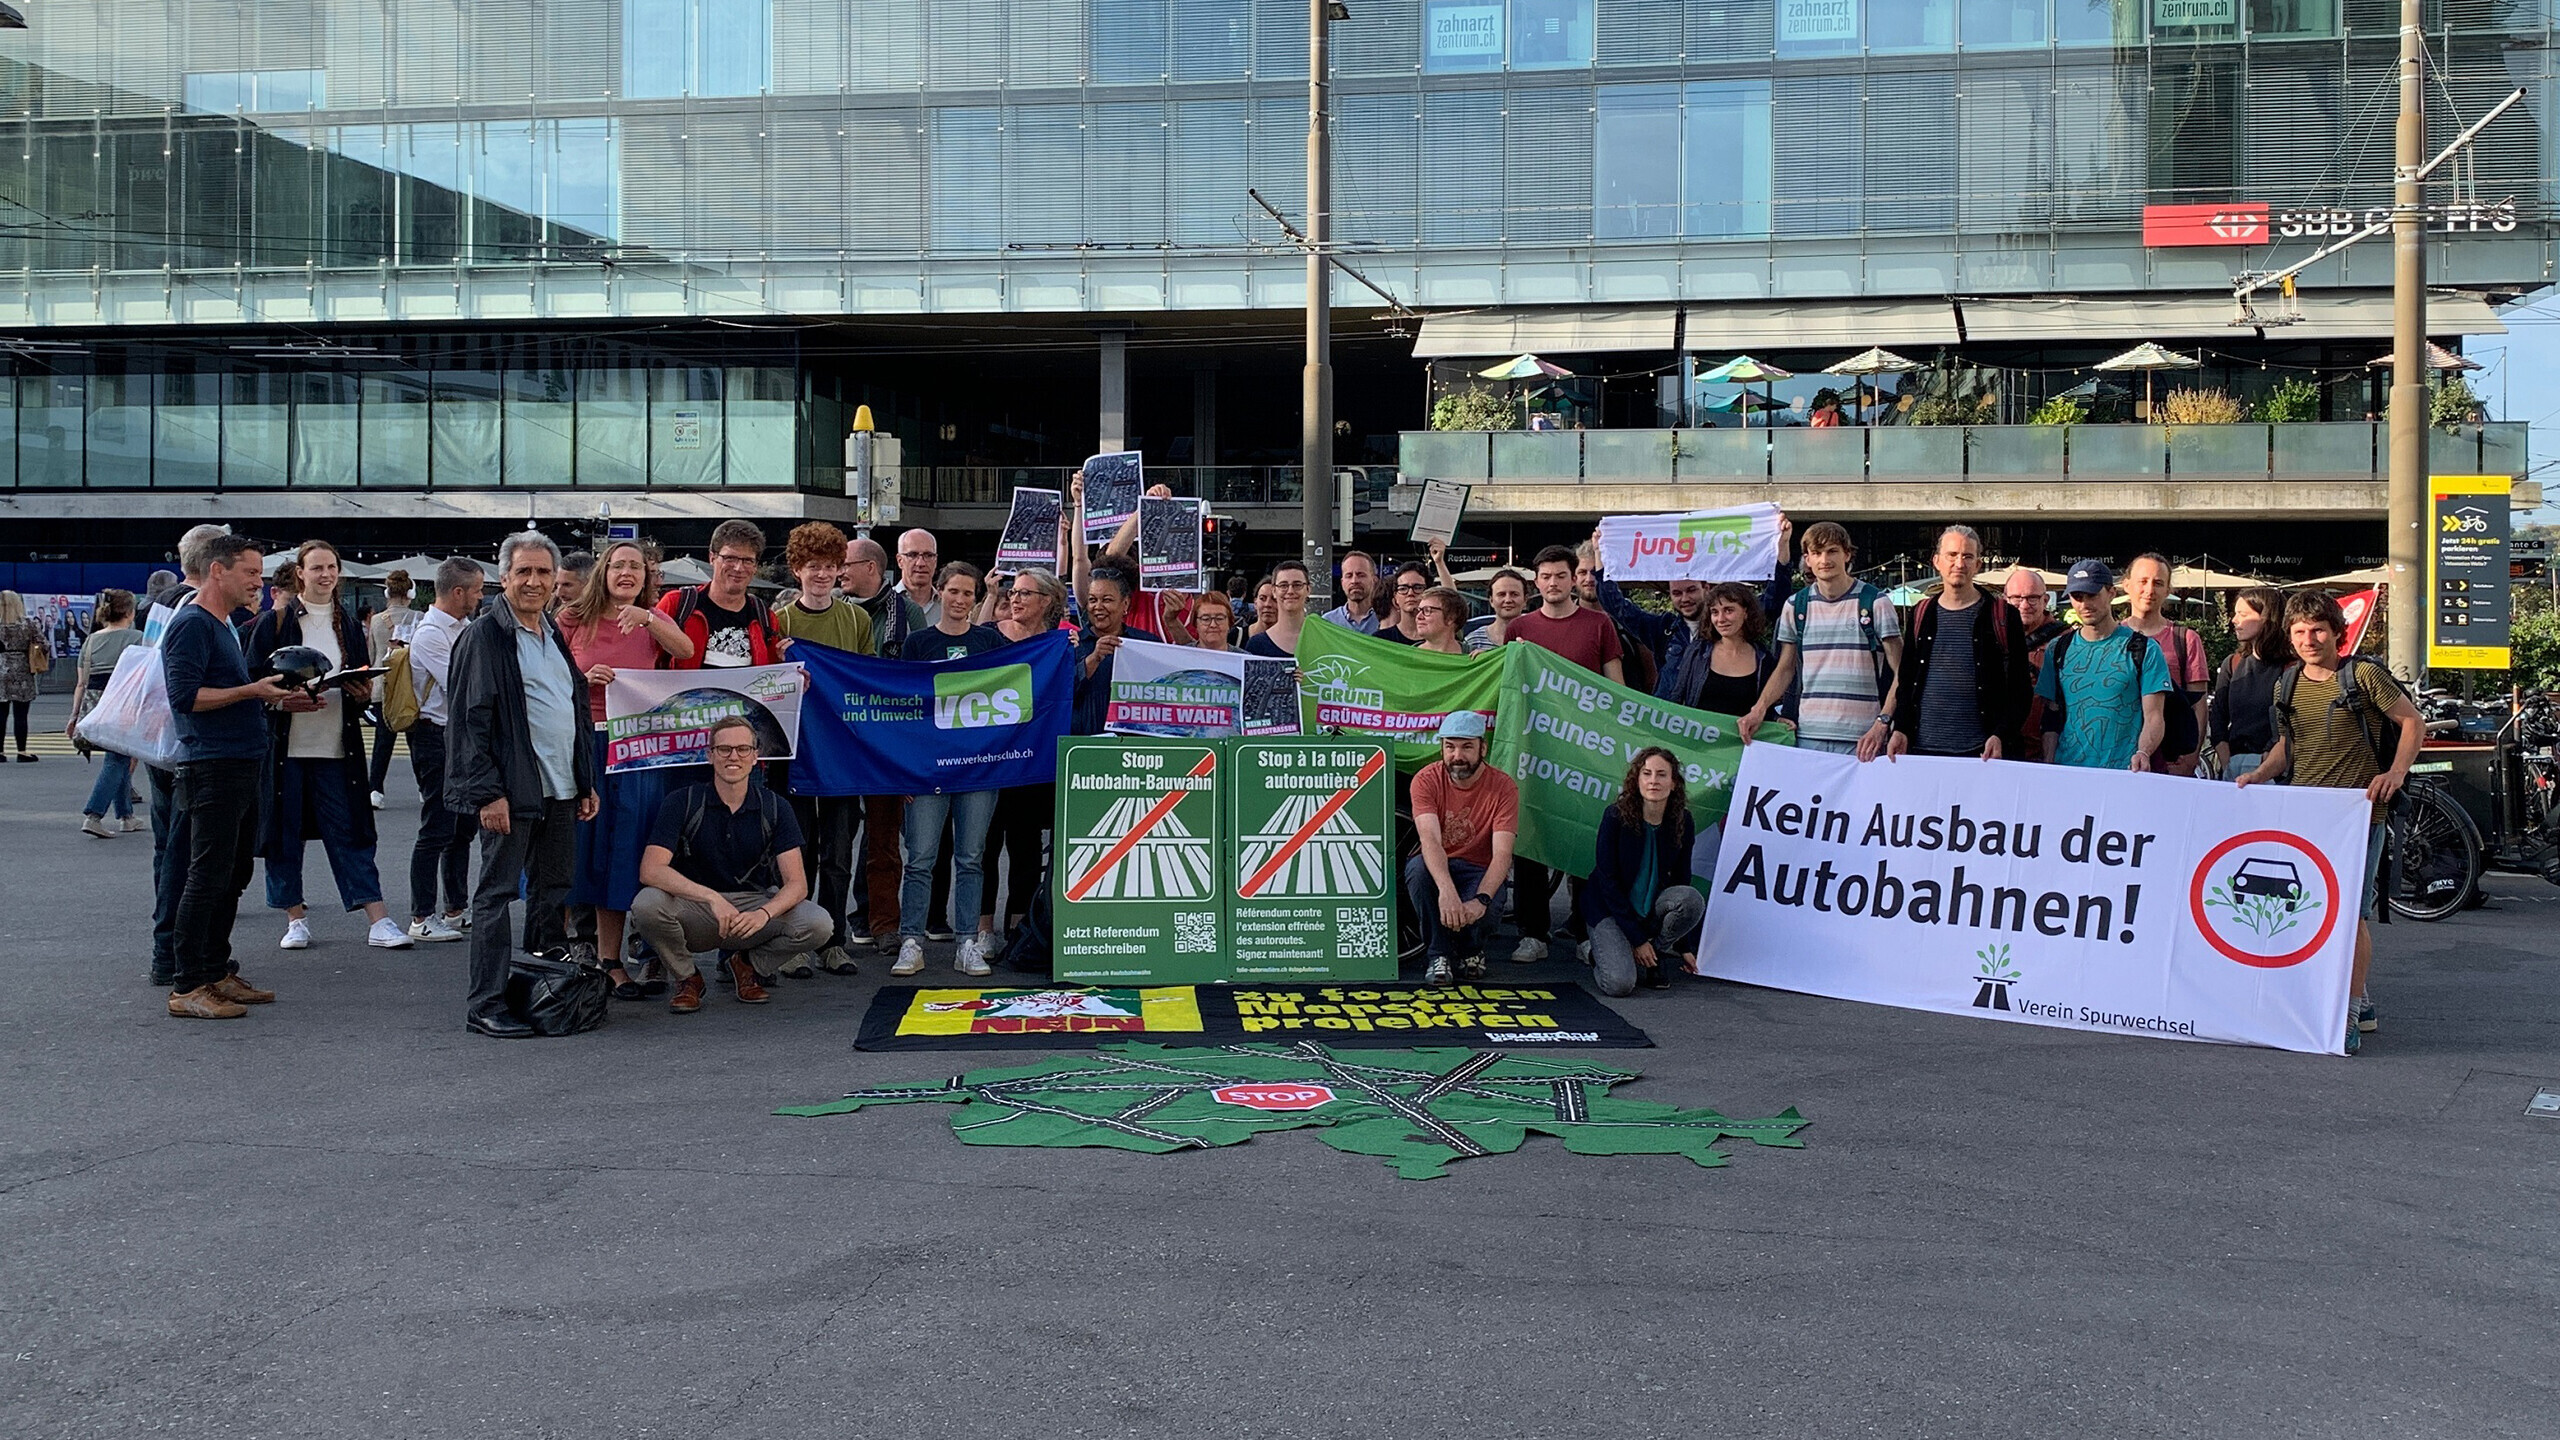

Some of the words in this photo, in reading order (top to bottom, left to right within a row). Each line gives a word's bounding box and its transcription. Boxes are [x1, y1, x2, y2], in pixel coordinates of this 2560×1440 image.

[1788, 0, 1849, 17] zahnarzt
[2162, 1, 2227, 17] zentrum.ch
[1437, 14, 1494, 33] zahnarzt
[1788, 16, 1850, 33] zentrum.ch
[1437, 32, 1495, 48] zentrum.ch
[2280, 208, 2353, 236] SBB
[1448, 554, 1497, 562] Restaurant
[1991, 555, 2020, 564] Away
[2249, 555, 2272, 564] Take
[2274, 555, 2303, 565] Away
[2344, 556, 2387, 564] Restaura
[844, 693, 865, 706] Für
[869, 693, 923, 706] Mensch
[1117, 684, 1178, 702] UNSER
[1182, 687, 1239, 704] KLIMA
[934, 688, 1021, 729] VCS
[1534, 668, 1613, 713] junge
[1616, 699, 1721, 744] gruene
[613, 716, 677, 737] UNSER
[680, 704, 742, 729] KLIMA
[843, 709, 867, 721] und
[870, 709, 924, 721] Umwelt
[1118, 706, 1173, 722] DEINE
[1177, 707, 1229, 725] WAHL
[1319, 707, 1382, 726] GRÜNES
[1522, 709, 1617, 756] jeunes
[616, 735, 670, 761] DEINE
[675, 729, 711, 750] WA
[937, 749, 1034, 767] www.verkehrsclub.ch
[1122, 751, 1164, 770] Stopp
[1258, 751, 1292, 768] Stop
[1297, 750, 1307, 767] à
[1311, 751, 1326, 767] la
[1331, 751, 1366, 767] folie
[1071, 773, 1212, 791] Autobahn-Bauwahn
[1264, 772, 1359, 789] autoroutière
[1518, 751, 1611, 801] giovani
[1742, 785, 1850, 844] Kein
[1860, 803, 2042, 859] Ausbau
[2060, 815, 2156, 868] der
[1723, 844, 2142, 944] Autobahnen!
[1236, 907, 1291, 917] Référendum
[1293, 908, 1322, 917] contre
[1063, 927, 1091, 938] Jetzt
[1093, 926, 1160, 938] Referendum
[1236, 921, 1286, 931] l'extension
[1287, 921, 1326, 931] effrénée
[1236, 935, 1253, 945] des
[1254, 936, 1306, 945] autoroutes.
[1063, 943, 1146, 955] unterschreiben
[1236, 949, 1269, 961] Signez
[1269, 949, 1324, 959] maintenant!
[1237, 1000, 1527, 1017] Monster-
[2018, 998, 2073, 1019] Verein
[2079, 1006, 2196, 1036] Spurwechsel
[971, 1016, 1146, 1032] NEIN
[1228, 1091, 1317, 1102] STOP
